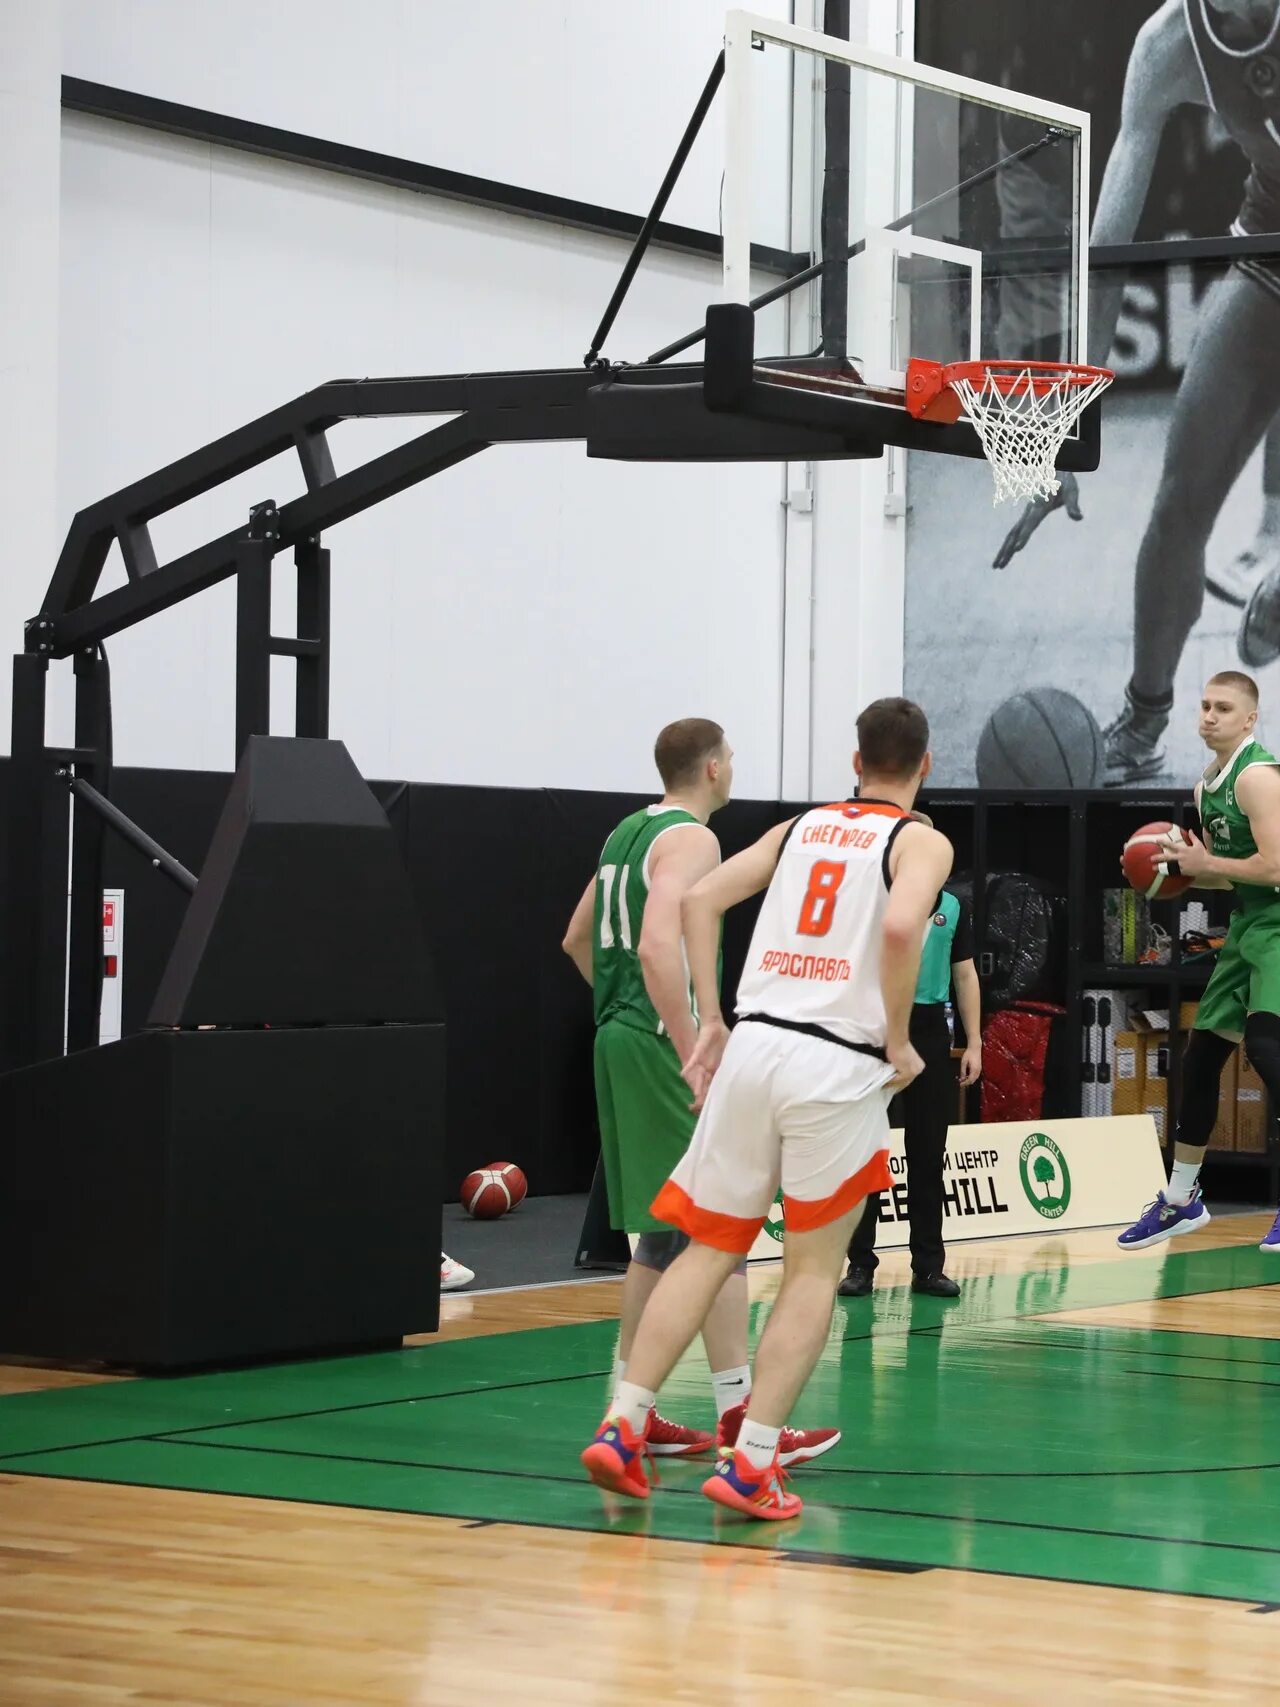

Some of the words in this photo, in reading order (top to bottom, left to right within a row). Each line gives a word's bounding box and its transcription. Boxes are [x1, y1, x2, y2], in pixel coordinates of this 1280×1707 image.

[802, 824, 877, 850] СНЕГИРЕВ
[599, 864, 632, 950] 11
[796, 858, 847, 938] 8
[1020, 1135, 1039, 1161] GREEN
[1044, 1136, 1062, 1160] HILL
[955, 1149, 999, 1174] ЦЕНТР
[942, 1176, 1009, 1217] HILL
[1040, 1205, 1065, 1218] CENTER
